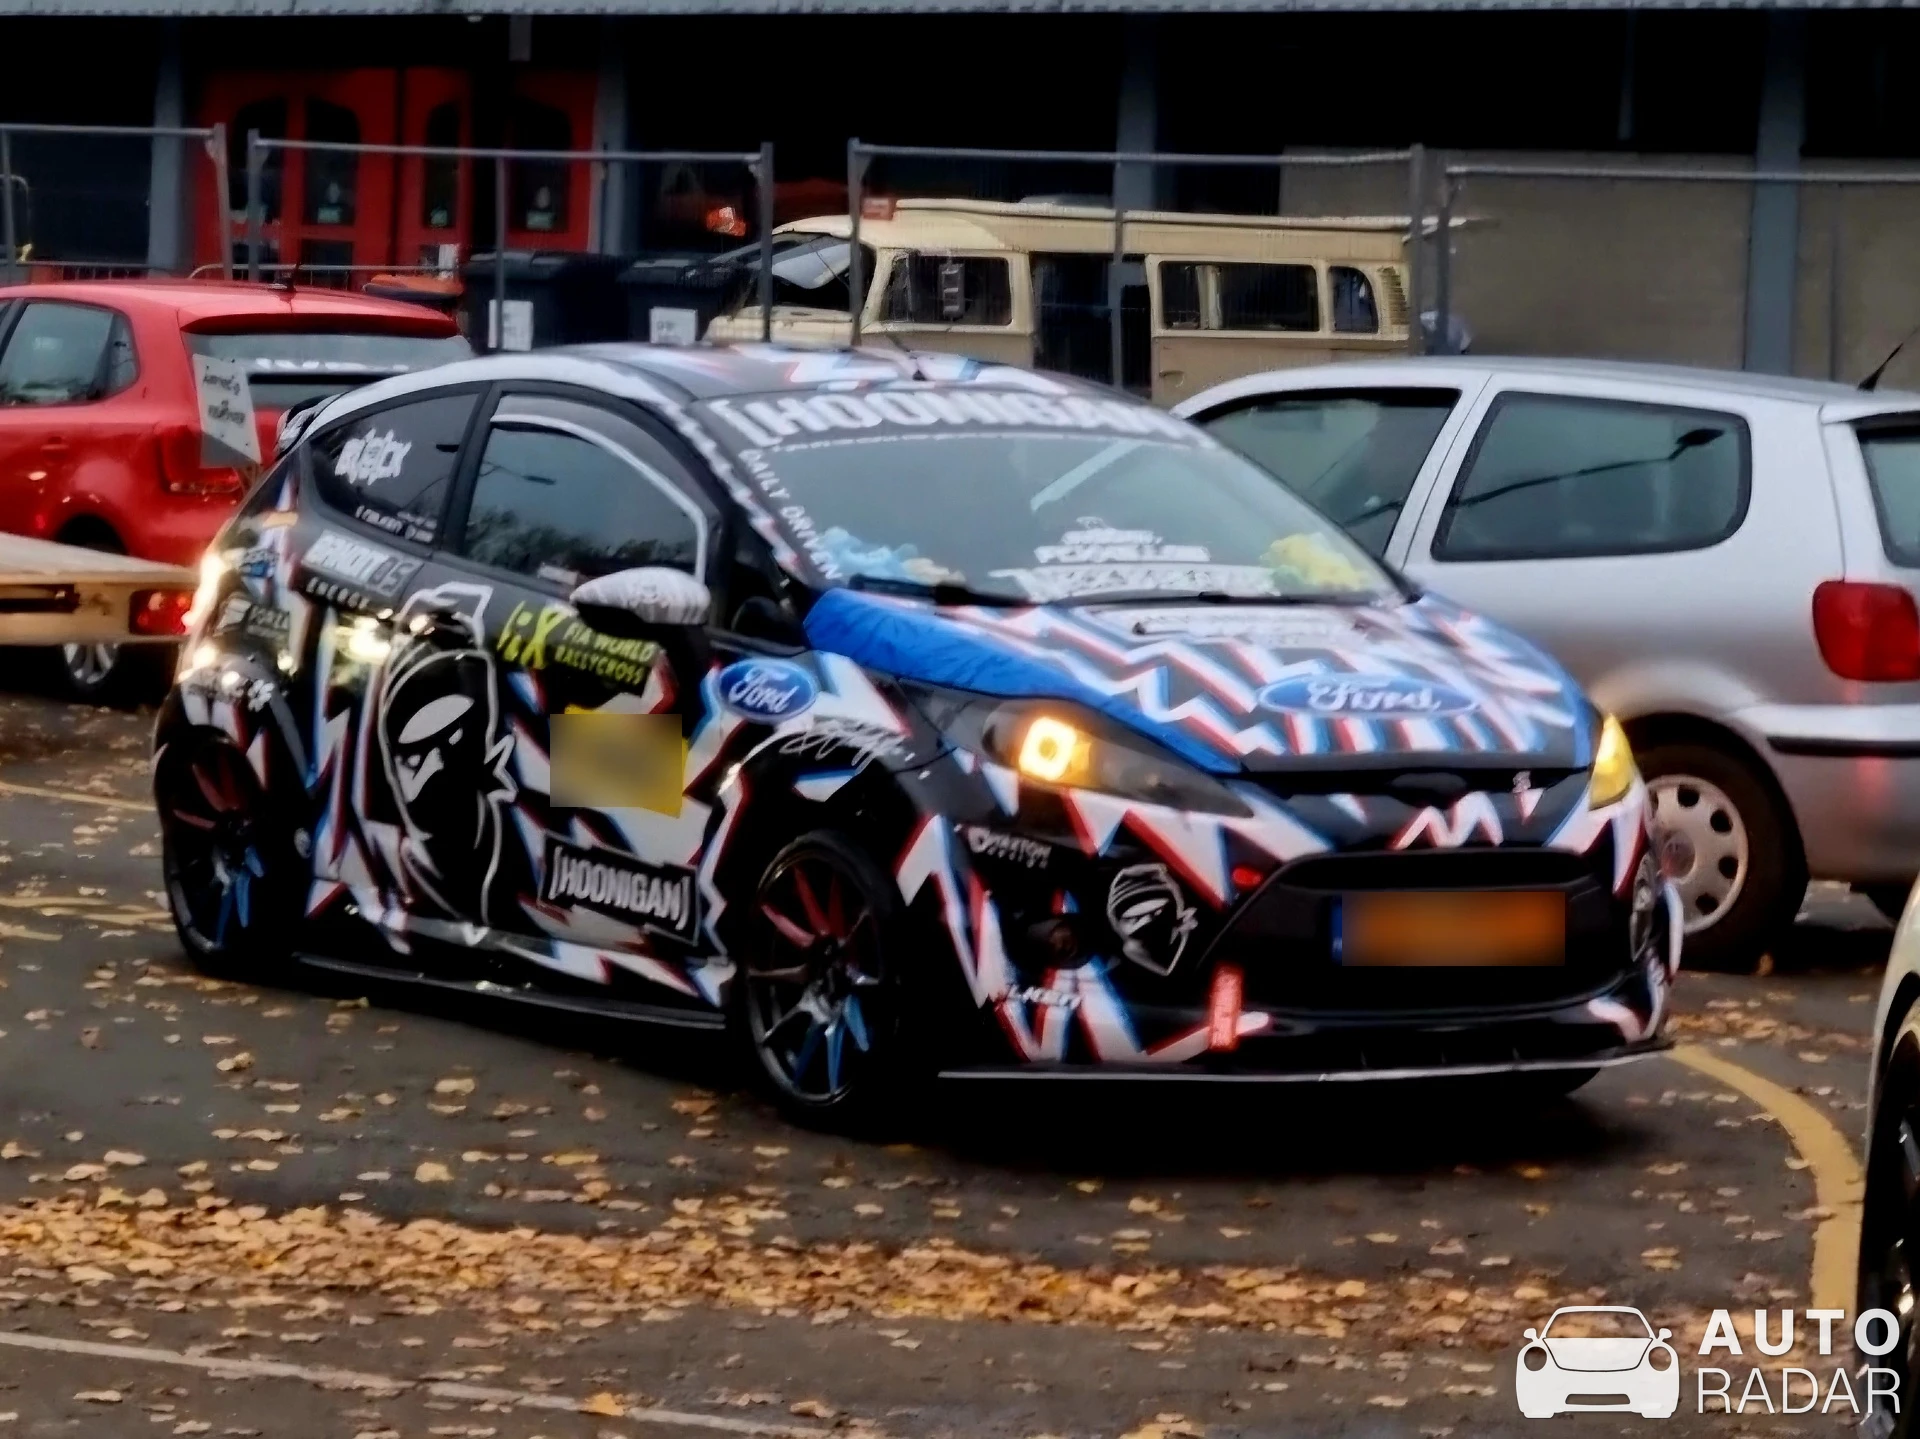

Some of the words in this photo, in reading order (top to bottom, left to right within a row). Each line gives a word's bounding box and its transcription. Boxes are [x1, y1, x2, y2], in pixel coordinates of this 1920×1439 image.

[738, 449, 790, 499] DAILY
[563, 621, 594, 646] FIA
[594, 632, 661, 664] WORLD
[554, 645, 647, 686] RALLYCROSS
[728, 665, 800, 714] Ford
[1305, 671, 1442, 713] Ford
